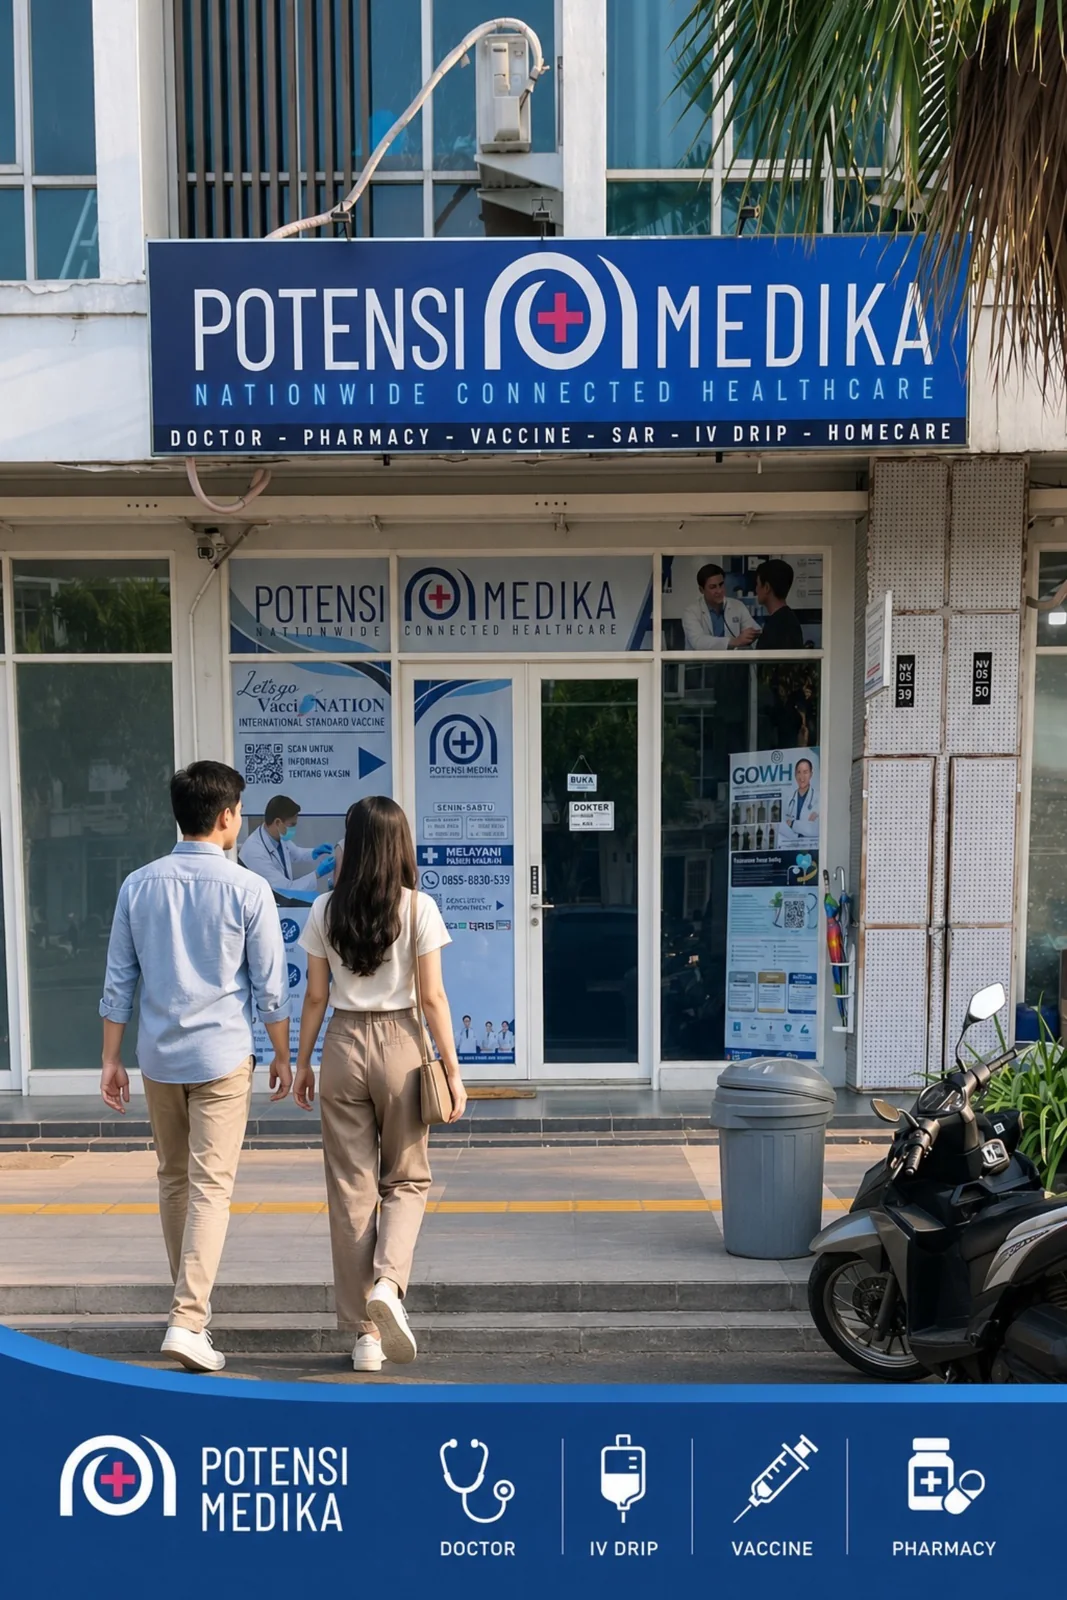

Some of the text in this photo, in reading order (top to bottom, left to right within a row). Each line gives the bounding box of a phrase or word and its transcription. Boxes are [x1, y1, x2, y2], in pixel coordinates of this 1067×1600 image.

[193, 282, 934, 371] POTENSI MEDIKA
[195, 378, 935, 406] NATIONWIDE CONNECTED HEALTHCARE
[170, 429, 262, 447] DOCTOR
[303, 428, 430, 446] PHARMACY
[470, 427, 572, 445] VACCINE
[612, 426, 655, 444] SAR
[695, 425, 718, 443] IV
[735, 424, 787, 442] DRIP
[828, 422, 952, 441] HOMECARE
[256, 580, 616, 623] POTENSI MEDIKA
[256, 624, 617, 638] NATIONWIDE CONNECTED HEALTHCARE
[899, 663, 913, 671] NV
[975, 660, 990, 669] NV
[898, 688, 912, 700] 39
[975, 686, 989, 697] 50
[239, 718, 303, 727] INTERNATIONAL
[351, 717, 385, 726] VACCINE
[288, 745, 334, 753] SCAN UNTUK
[288, 757, 329, 766] INFORMASI
[288, 770, 351, 778] TENTANG VAKSIN
[429, 766, 499, 774] POTENSI MEDIKA
[570, 776, 594, 784] BUKA
[573, 803, 610, 812] DOKTER
[446, 847, 502, 857] MELAYANI
